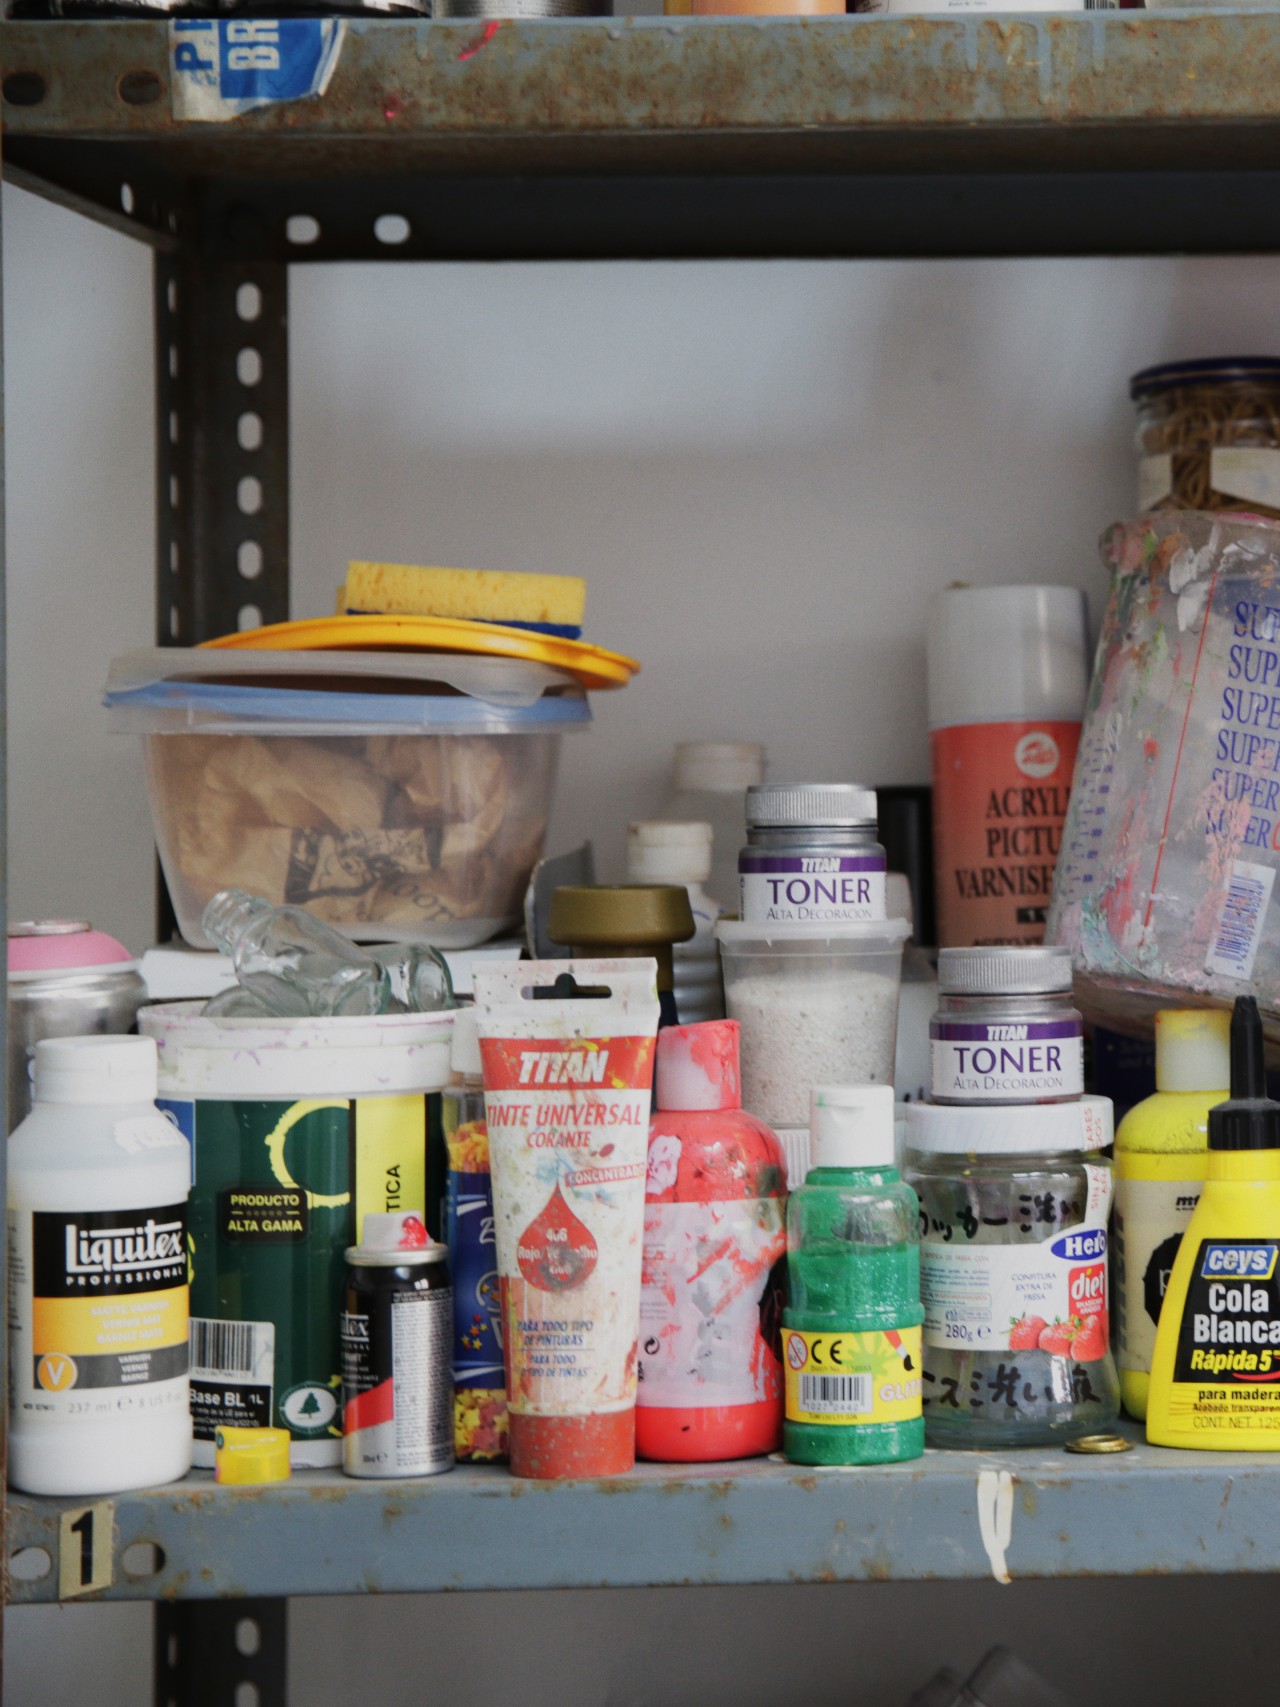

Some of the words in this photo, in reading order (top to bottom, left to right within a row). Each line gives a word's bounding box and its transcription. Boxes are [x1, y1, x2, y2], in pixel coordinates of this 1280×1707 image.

[987, 826, 1063, 858] PICTU
[801, 857, 841, 873] TITAN
[767, 878, 871, 905] TONER
[767, 907, 793, 920] ALTA
[986, 1025, 1029, 1041] TITAN
[518, 1049, 610, 1084] TITAN
[953, 1045, 1062, 1074] TONER
[953, 1076, 979, 1089] ALTA
[487, 1104, 531, 1128] TINTE
[536, 1103, 642, 1128] UNIVERSAL
[526, 1131, 592, 1148] CORANTE
[230, 1194, 300, 1206] PRODUCTO
[227, 1219, 259, 1232] ALTA
[262, 1220, 303, 1232] GAMA
[66, 1219, 186, 1272] Liquitex
[1065, 1231, 1107, 1257] Hero
[1209, 1249, 1268, 1275] ceys
[66, 1266, 183, 1286] PROFESSIONAL
[1071, 1268, 1105, 1300] diet
[1209, 1283, 1269, 1313] Cola
[542, 1320, 568, 1332] TODO
[572, 1320, 594, 1332] TIPO
[945, 1324, 974, 1341] 280g
[537, 1334, 584, 1346] PINTURAS
[552, 1354, 576, 1364] TODO
[1190, 1348, 1259, 1375] Rápida
[47, 1361, 65, 1386] V
[559, 1366, 588, 1377] TINTAS
[224, 1391, 246, 1407] BL
[1198, 1389, 1227, 1402] para
[1192, 1403, 1229, 1413] Acabado
[71, 1510, 93, 1586] 1
